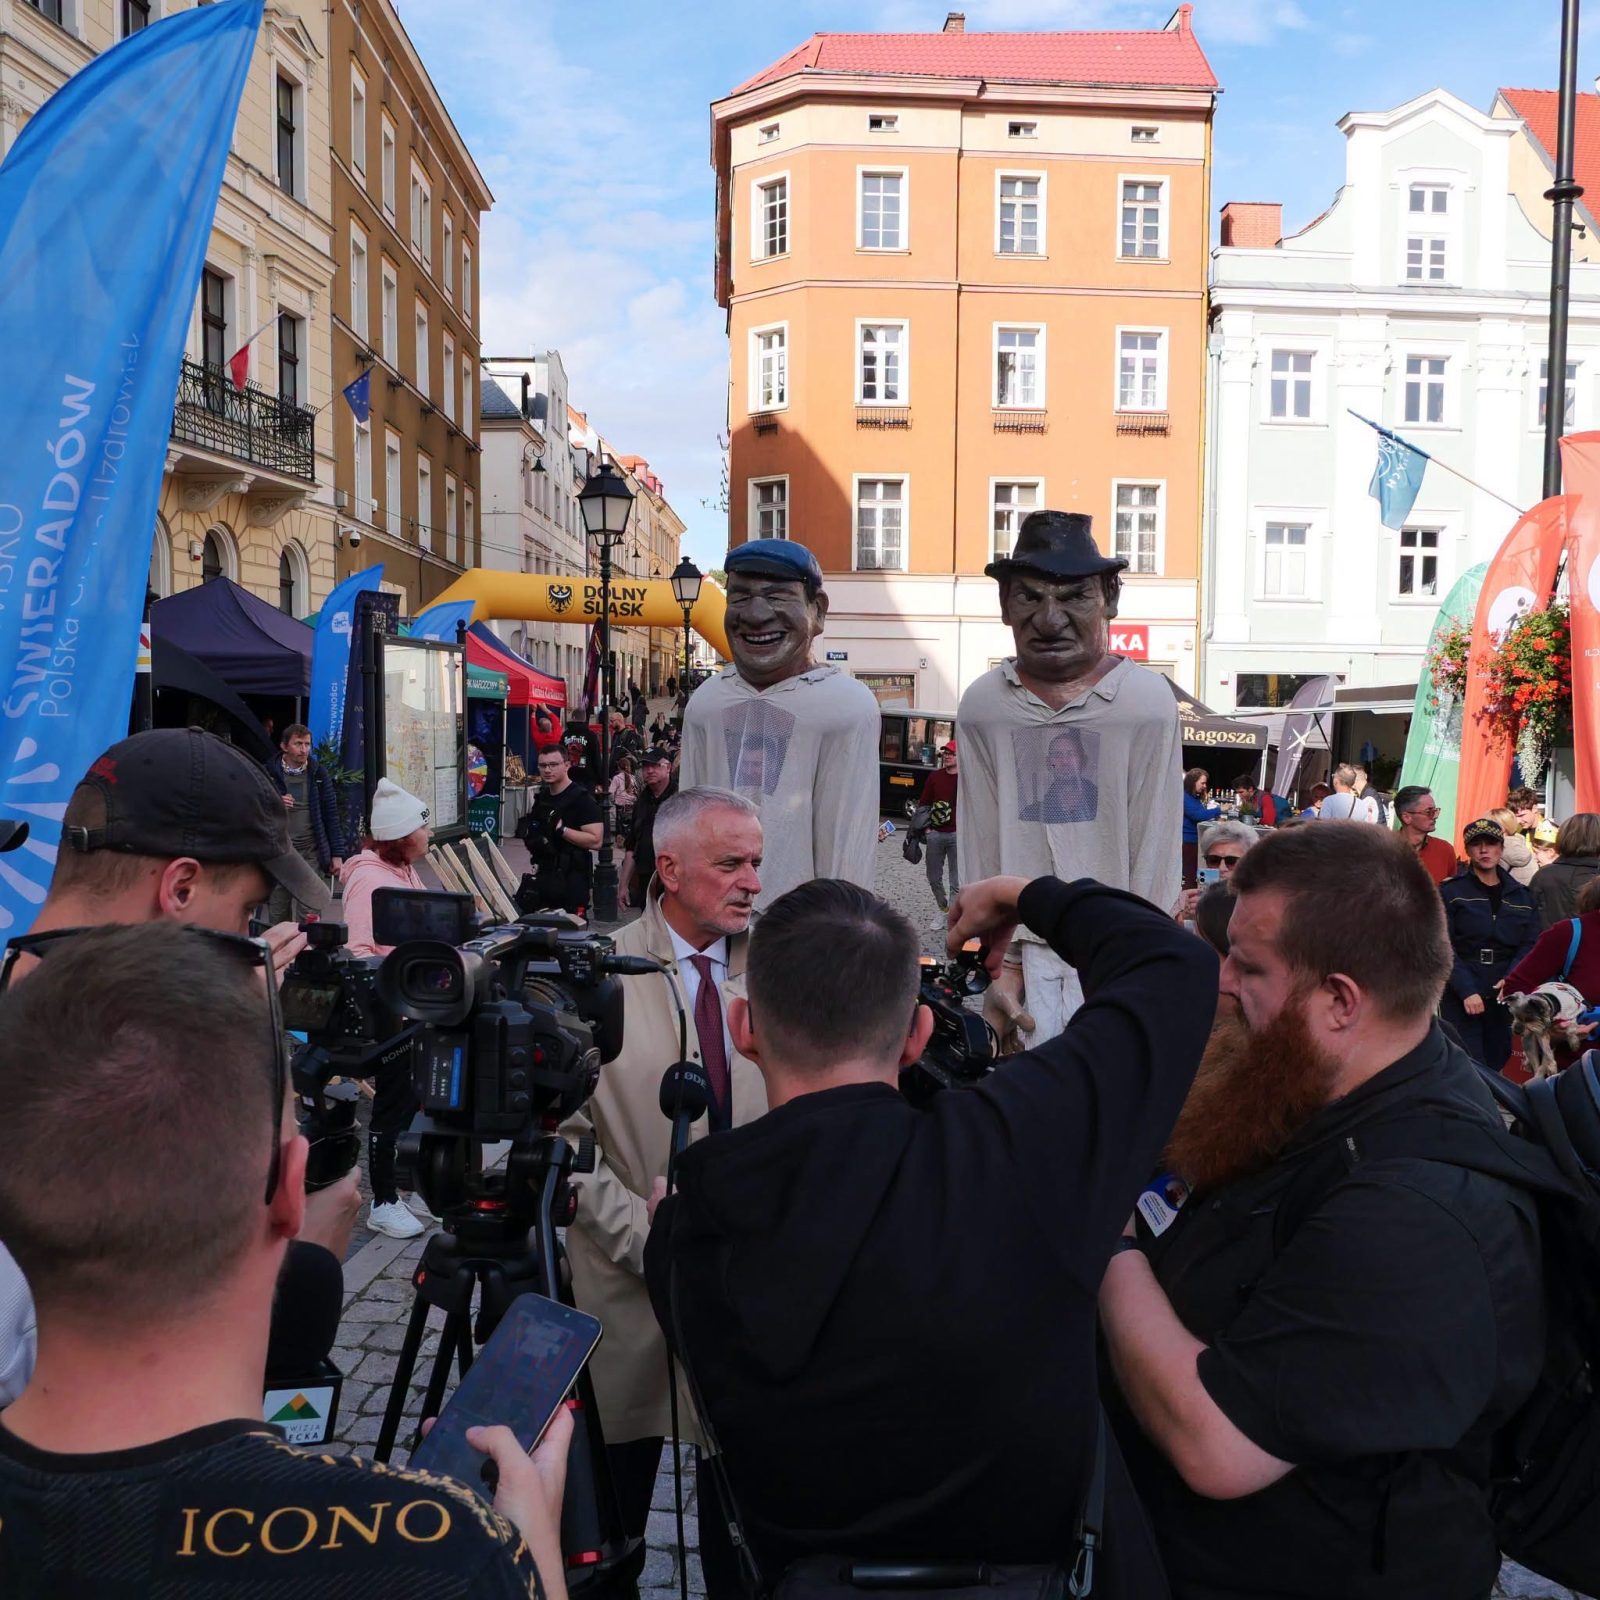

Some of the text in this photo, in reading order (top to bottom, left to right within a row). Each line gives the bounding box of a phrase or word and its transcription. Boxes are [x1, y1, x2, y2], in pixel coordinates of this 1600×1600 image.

[2, 373, 97, 719] ŚWIERADÓW
[583, 585, 648, 601] DOLNY
[582, 597, 643, 617] ŚLĄSK
[1110, 633, 1145, 651] KA
[39, 617, 80, 718] Polska
[886, 676, 893, 685] 4
[1183, 726, 1256, 746] Ragosza
[288, 1432, 319, 1442] ECKA
[289, 1423, 320, 1432] WIZJA
[175, 1499, 453, 1558] ICONO
